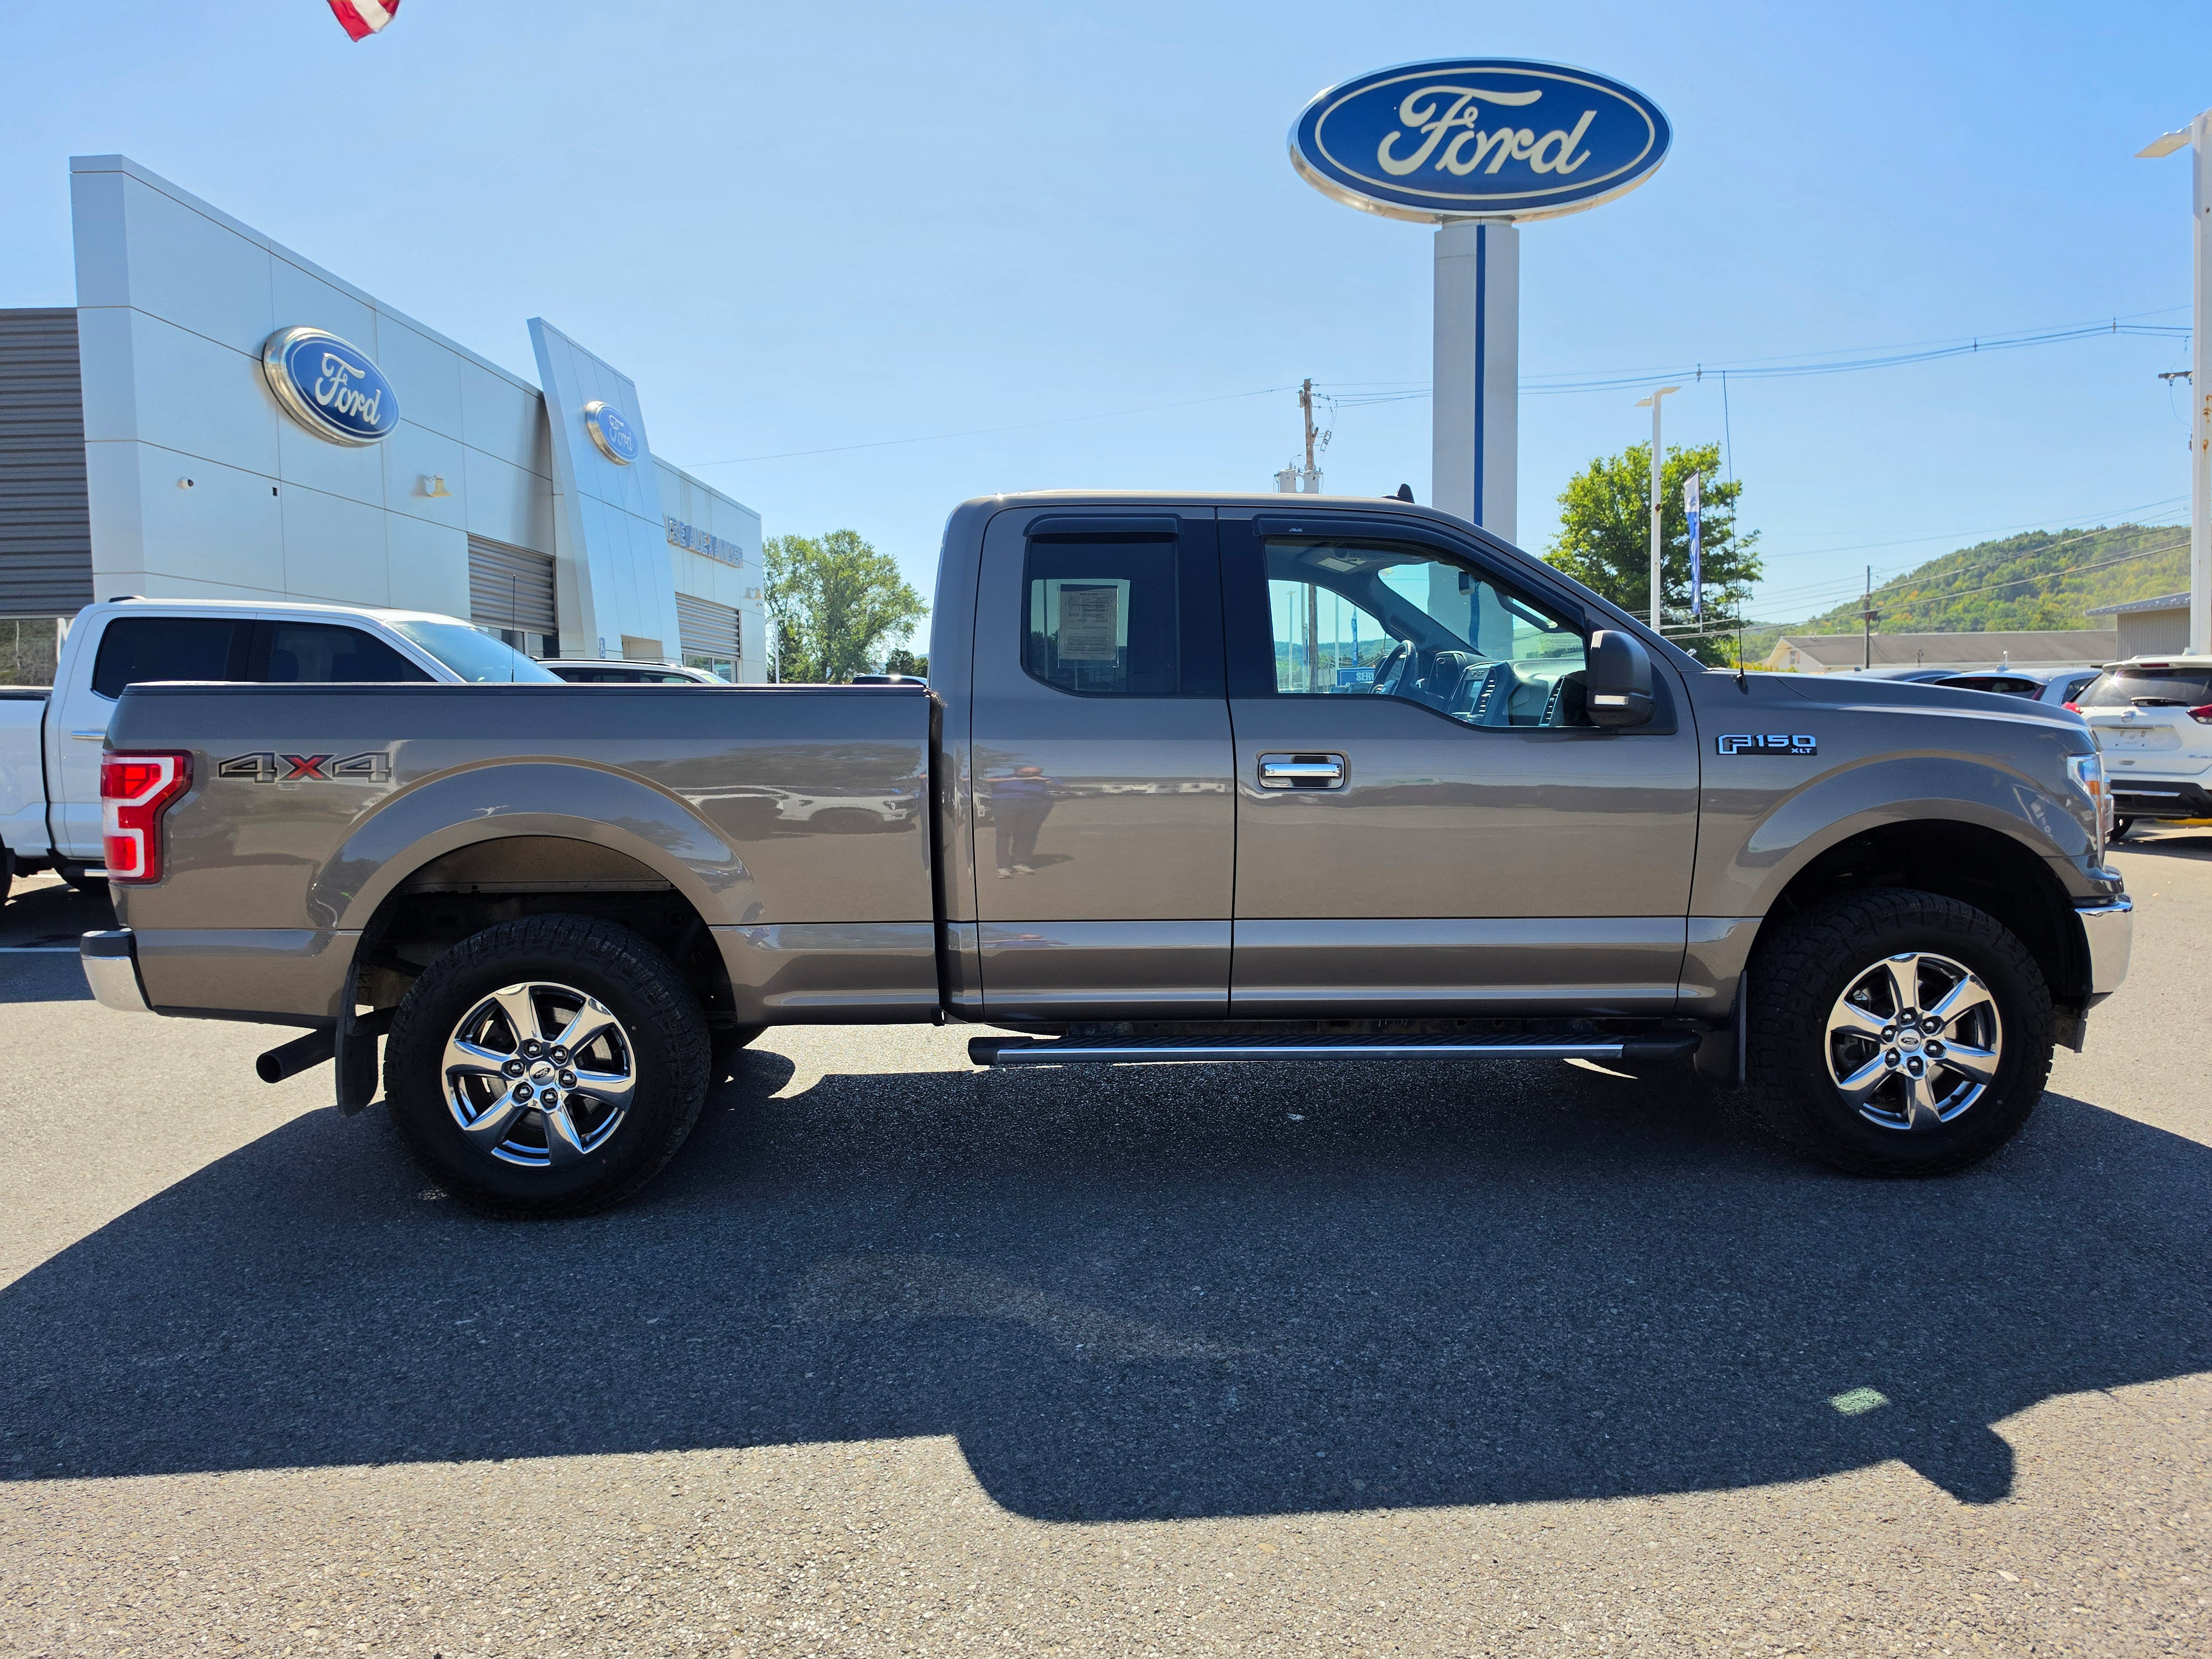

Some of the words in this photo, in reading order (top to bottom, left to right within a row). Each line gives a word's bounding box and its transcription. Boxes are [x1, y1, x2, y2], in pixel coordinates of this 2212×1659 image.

[1378, 85, 1598, 176] Ford
[315, 352, 382, 425] Ford
[609, 415, 633, 452] Ford
